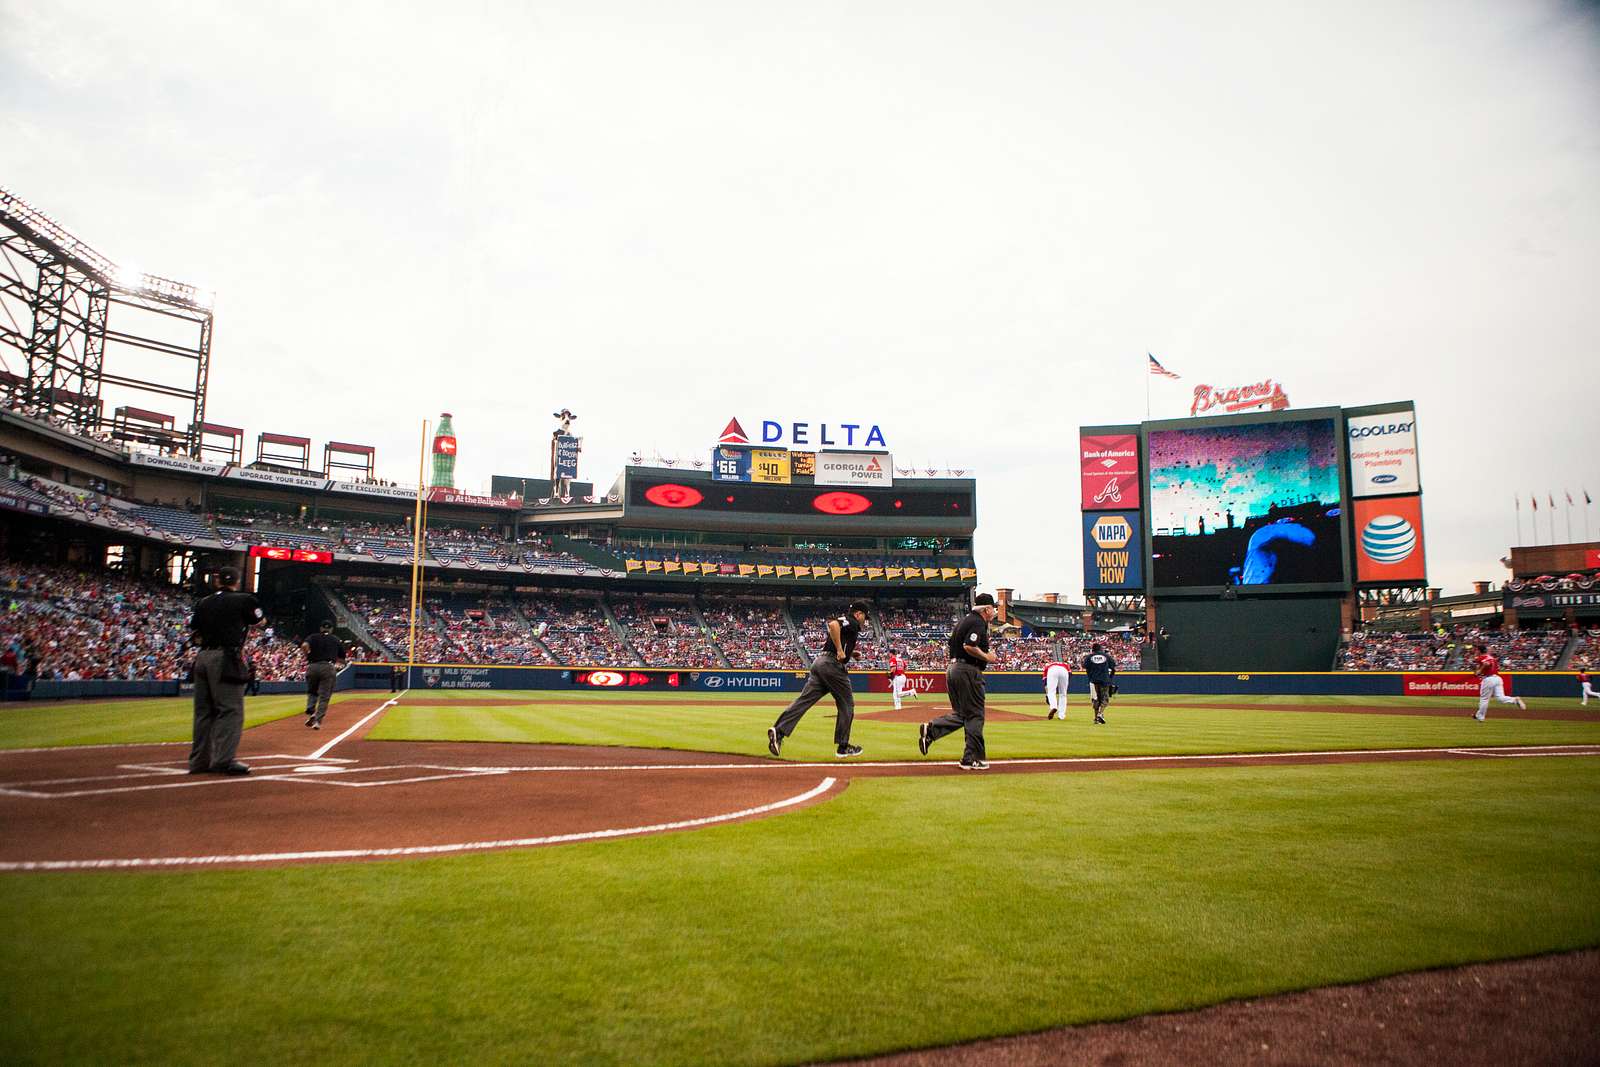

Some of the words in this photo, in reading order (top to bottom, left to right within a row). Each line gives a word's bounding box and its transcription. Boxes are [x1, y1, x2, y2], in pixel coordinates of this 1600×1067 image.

[1191, 379, 1274, 416] Braves
[762, 420, 887, 447] DELTA
[1350, 421, 1415, 438] COOLRAY
[1084, 450, 1100, 458] Bank
[1101, 450, 1108, 458] of
[147, 457, 188, 469] DOWNLOAD
[201, 465, 216, 473] APP
[758, 463, 779, 475] $40
[239, 472, 273, 481] UPGRADE
[356, 486, 391, 495] EXCLUSIVE
[455, 495, 464, 503] At
[465, 496, 476, 504] the
[476, 497, 508, 507] Ballpark
[1280, 494, 1317, 506] DELTA
[1098, 525, 1127, 541] NAPA
[1096, 552, 1129, 568] KNOW
[1100, 568, 1126, 584] HOW
[727, 677, 781, 688] HYUNDAI
[888, 676, 934, 692] xnity
[1409, 682, 1431, 691] Bank
[1432, 681, 1442, 690] of
[1442, 681, 1479, 691] America
